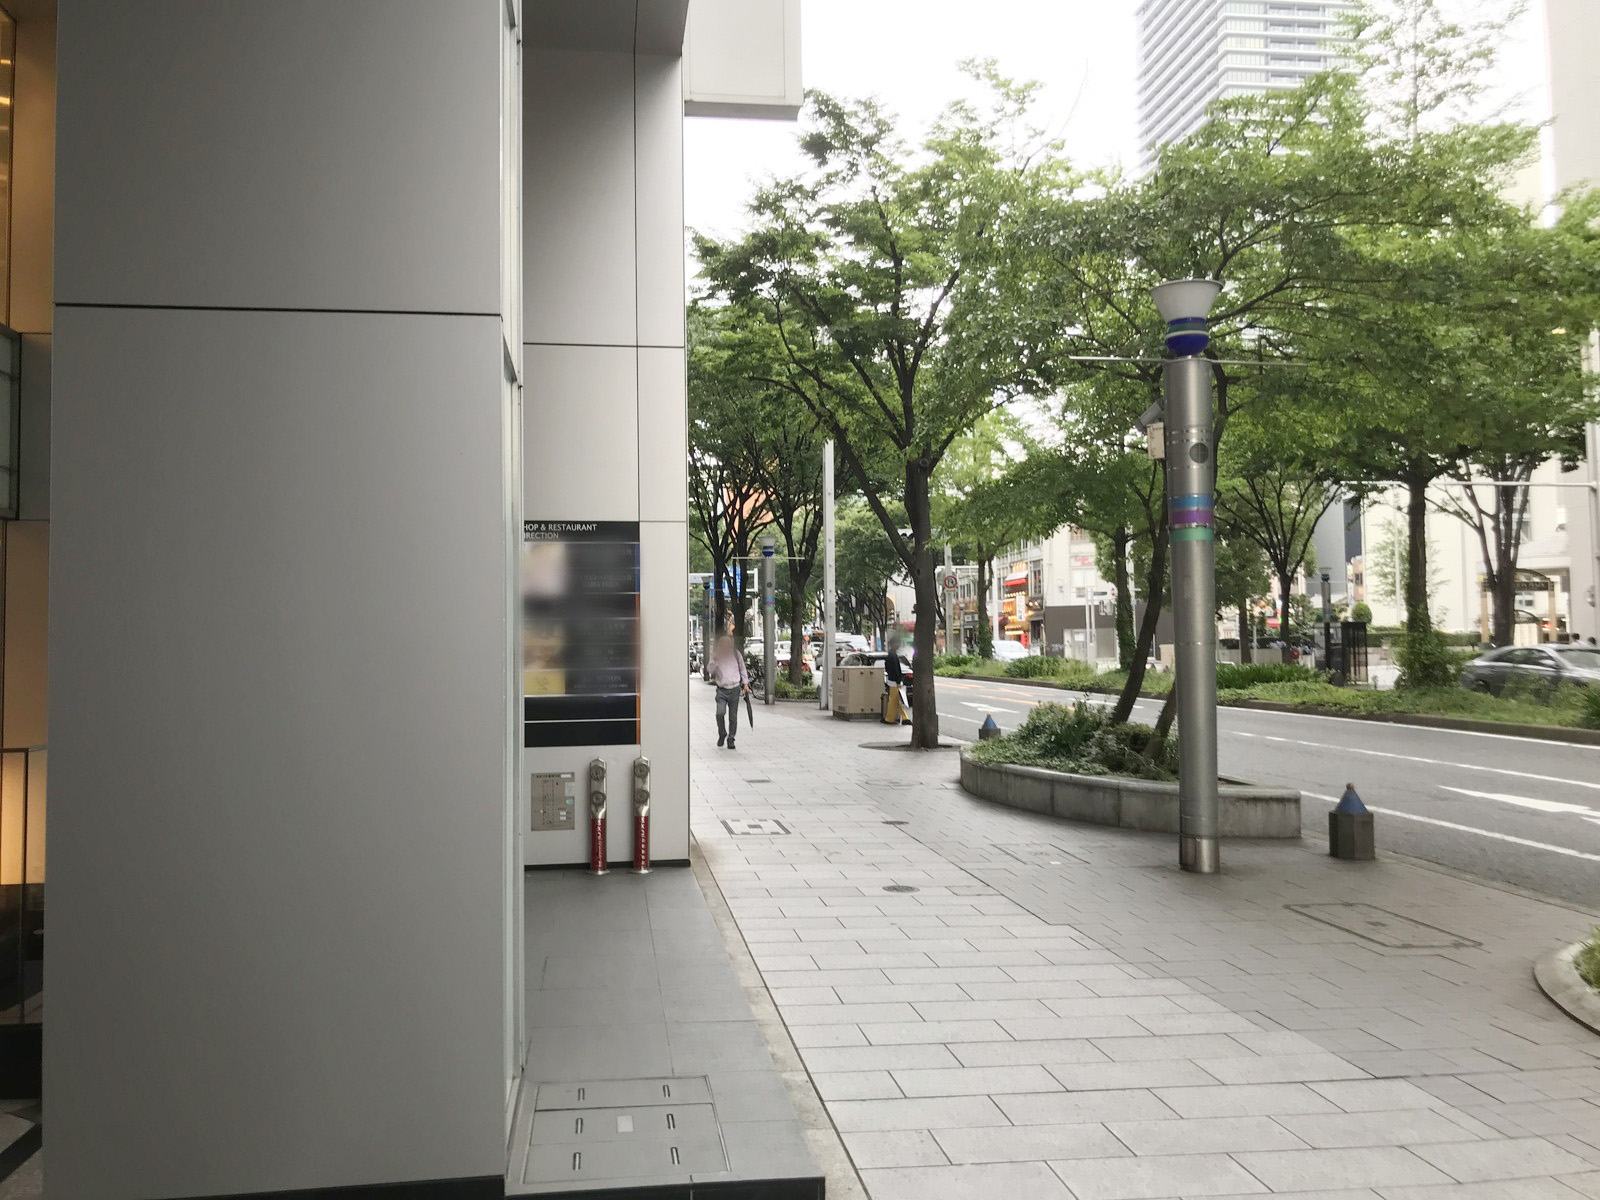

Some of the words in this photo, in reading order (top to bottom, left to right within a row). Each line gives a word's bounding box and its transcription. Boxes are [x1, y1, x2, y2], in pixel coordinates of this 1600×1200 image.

[523, 523, 539, 531] HOP
[540, 523, 547, 531] &
[548, 523, 598, 531] RESTAURANT
[523, 532, 559, 540] IRECTION
